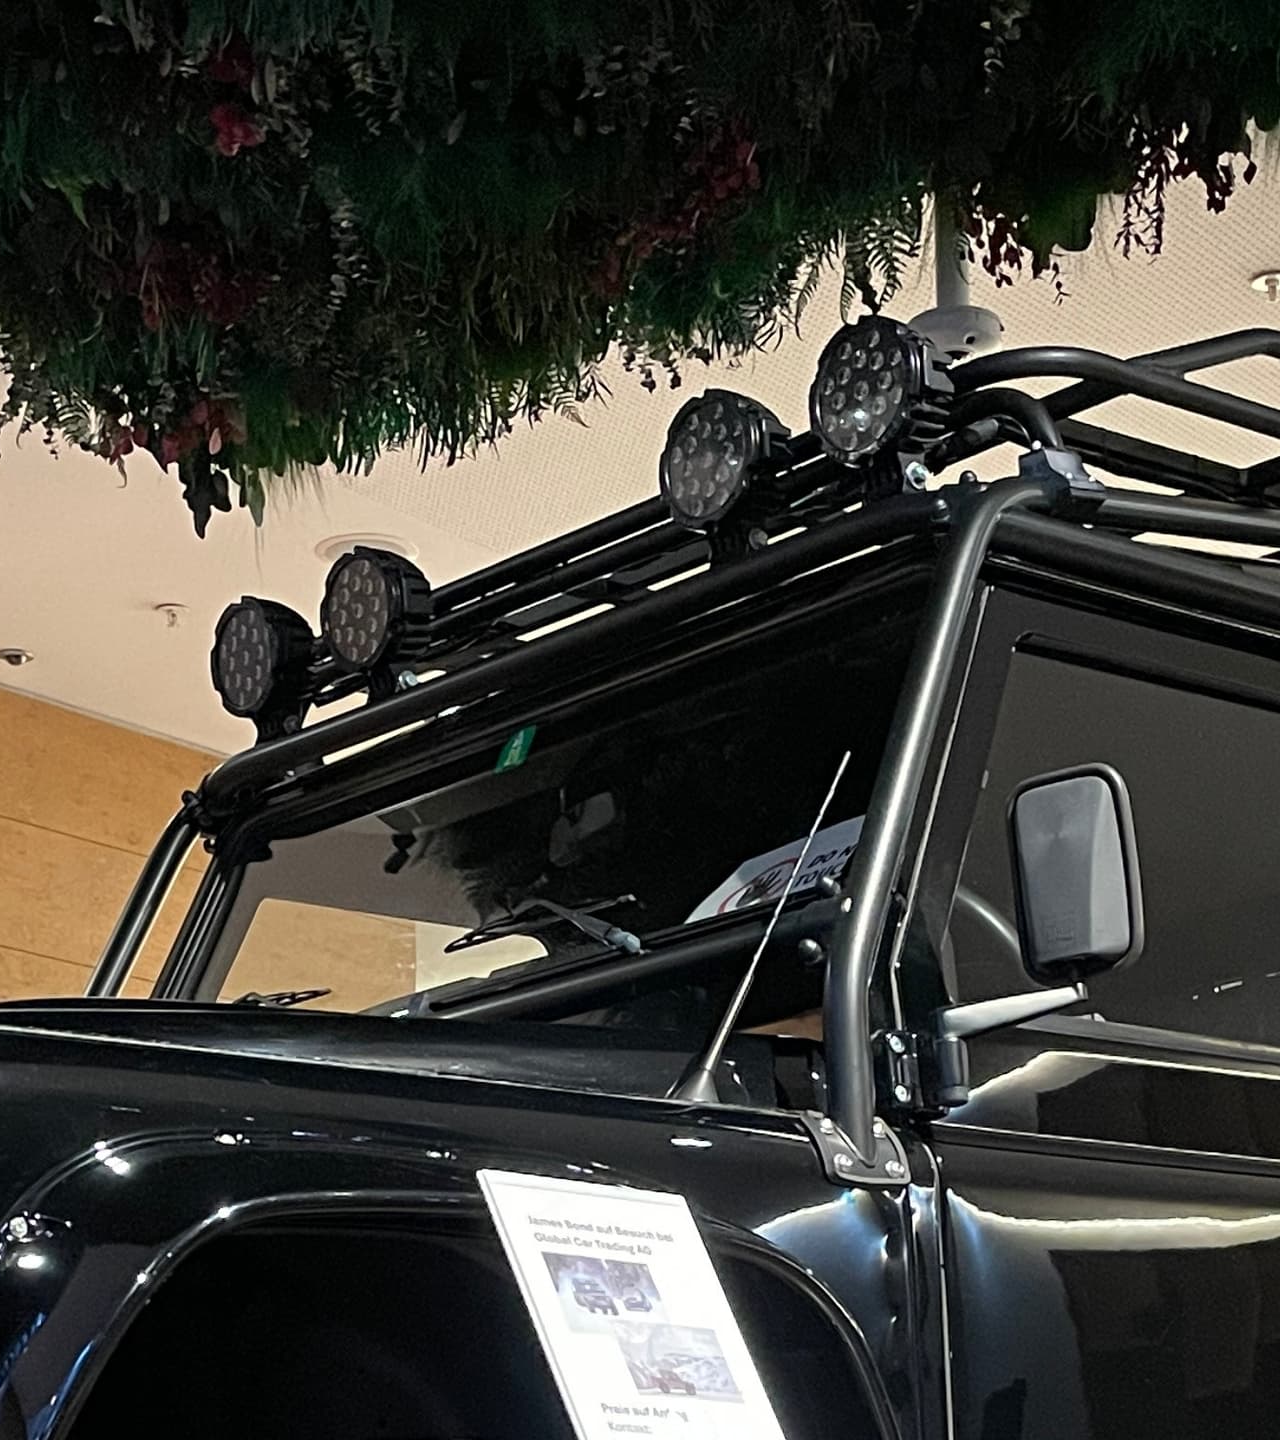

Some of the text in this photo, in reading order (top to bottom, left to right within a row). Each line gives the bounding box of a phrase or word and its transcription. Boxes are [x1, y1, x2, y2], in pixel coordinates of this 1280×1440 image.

[807, 850, 838, 869] DO
[794, 862, 845, 888] TOUC
[528, 1214, 564, 1229] James
[564, 1219, 594, 1232] Bond
[596, 1224, 613, 1235] auf
[614, 1226, 655, 1240] Besuch
[533, 1232, 652, 1256] Global Car Trading AG
